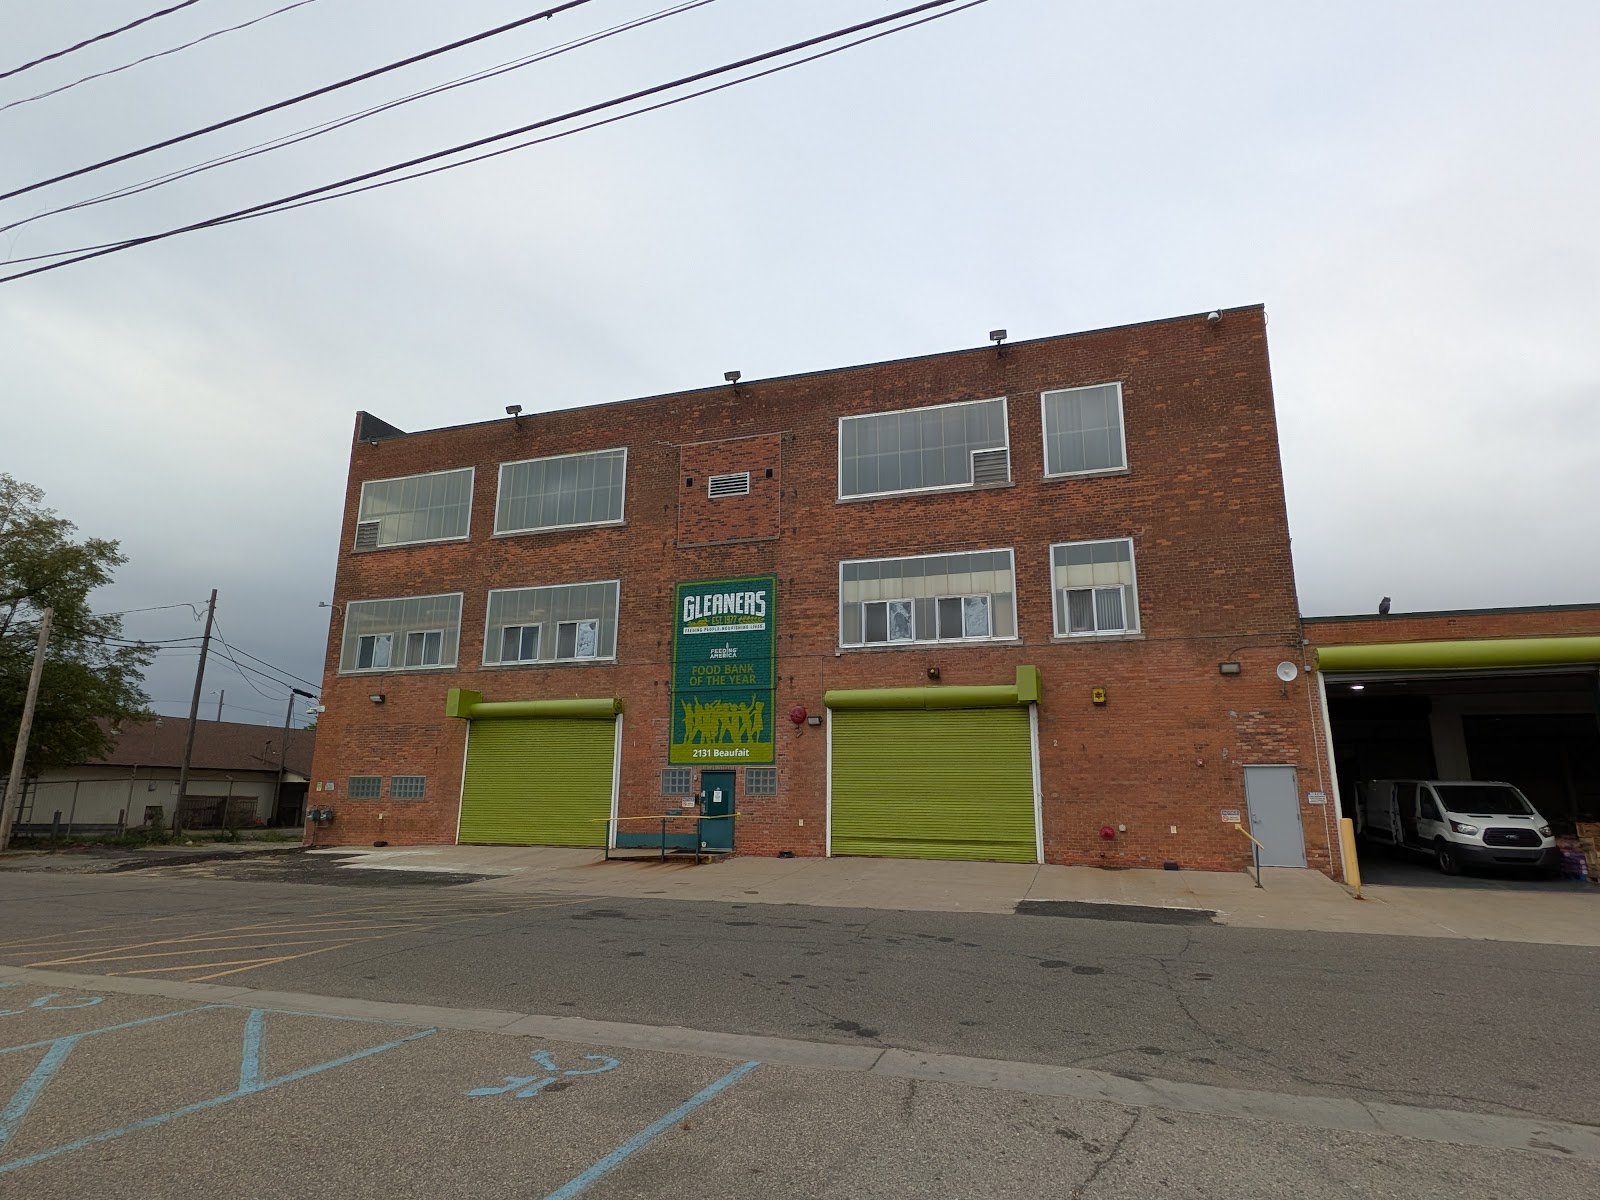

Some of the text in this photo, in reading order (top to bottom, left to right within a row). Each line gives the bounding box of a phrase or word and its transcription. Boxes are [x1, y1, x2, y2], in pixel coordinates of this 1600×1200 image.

[683, 590, 766, 622] GLEANERS
[724, 615, 737, 624] 1977
[710, 646, 737, 654] FEEDING
[692, 664, 754, 675] FOOD BANK
[690, 674, 756, 686] OF THE YEAR
[693, 748, 750, 757] 2131 Beaufait
